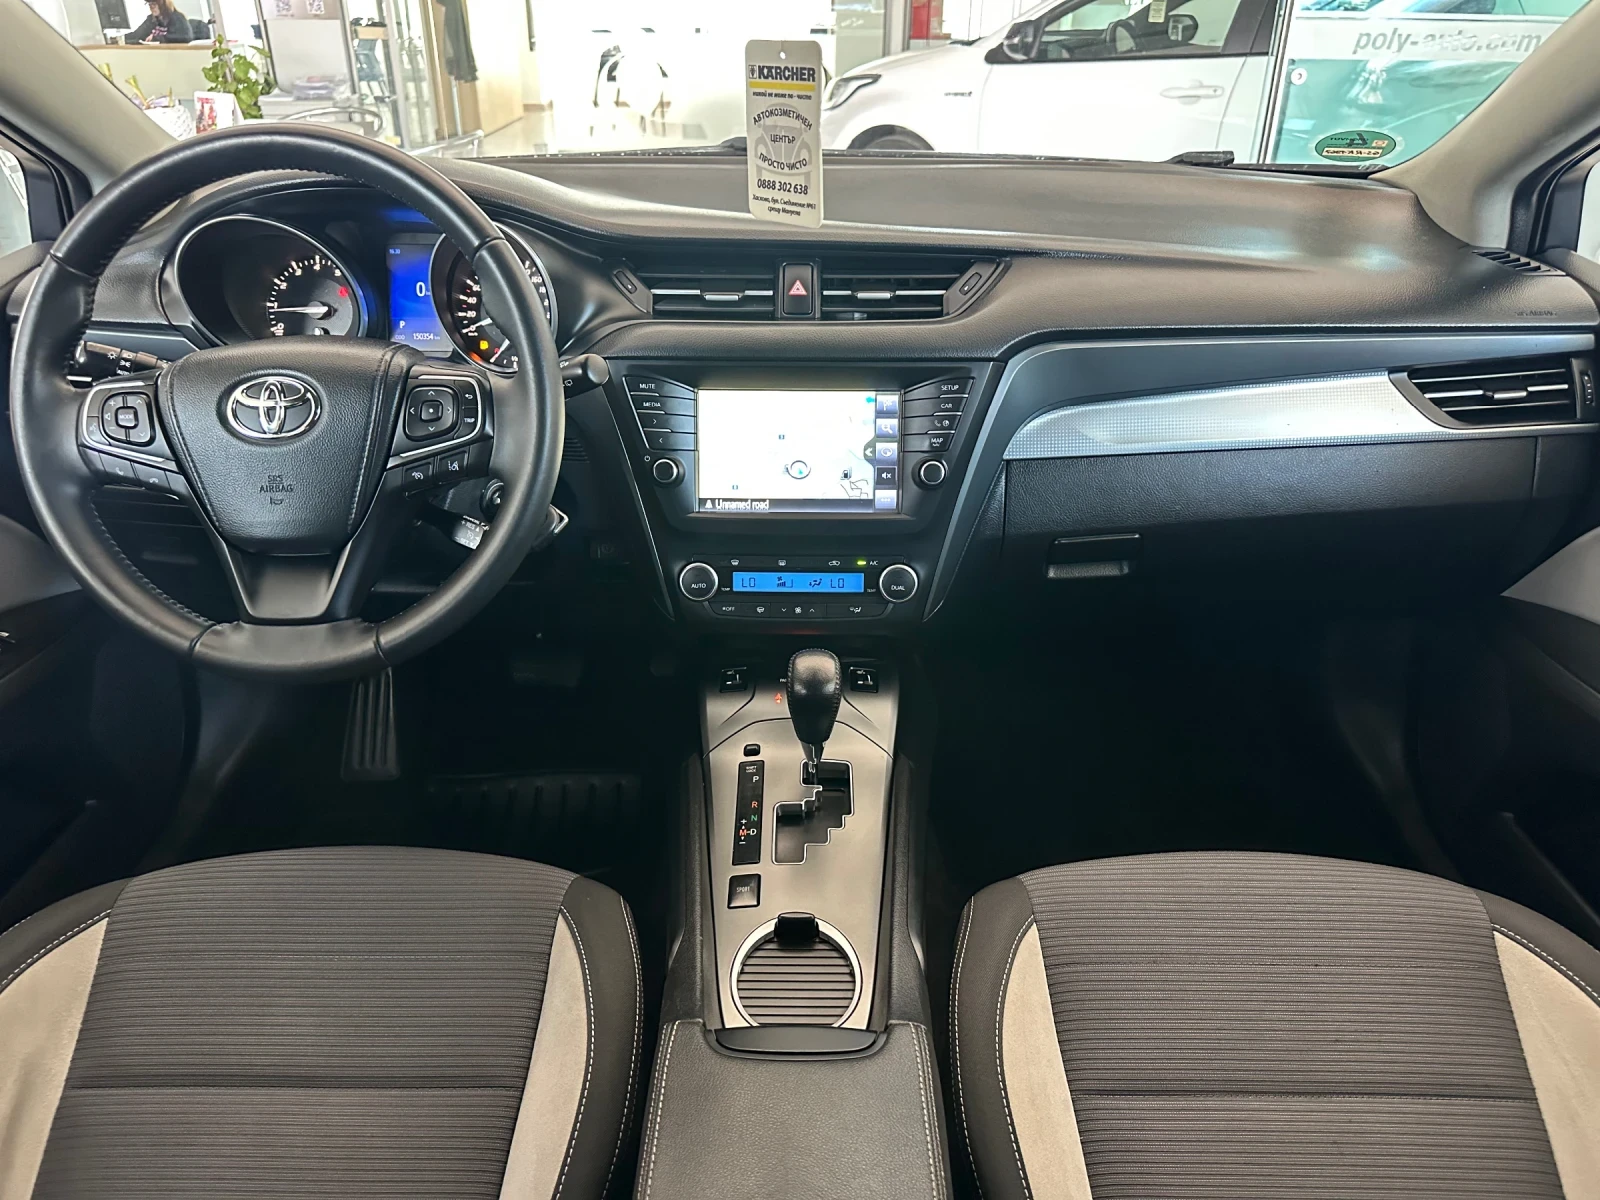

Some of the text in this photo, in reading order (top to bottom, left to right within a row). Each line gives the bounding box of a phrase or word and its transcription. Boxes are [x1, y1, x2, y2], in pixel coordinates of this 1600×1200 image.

[753, 107, 813, 131] АВТОКОЗМЕТИЧЕН
[770, 133, 796, 144] ЦЕНТЪР
[759, 152, 808, 171] ПРОСТО ЧИСТО
[757, 178, 809, 195] 0888 302 638
[415, 281, 426, 297] 0
[399, 320, 406, 329] P
[413, 332, 434, 341] 150354
[267, 474, 284, 482] SRS
[259, 483, 294, 493] AIRBAG
[715, 498, 769, 510] Unnamed road
[752, 775, 760, 783] P
[750, 814, 758, 822] N
